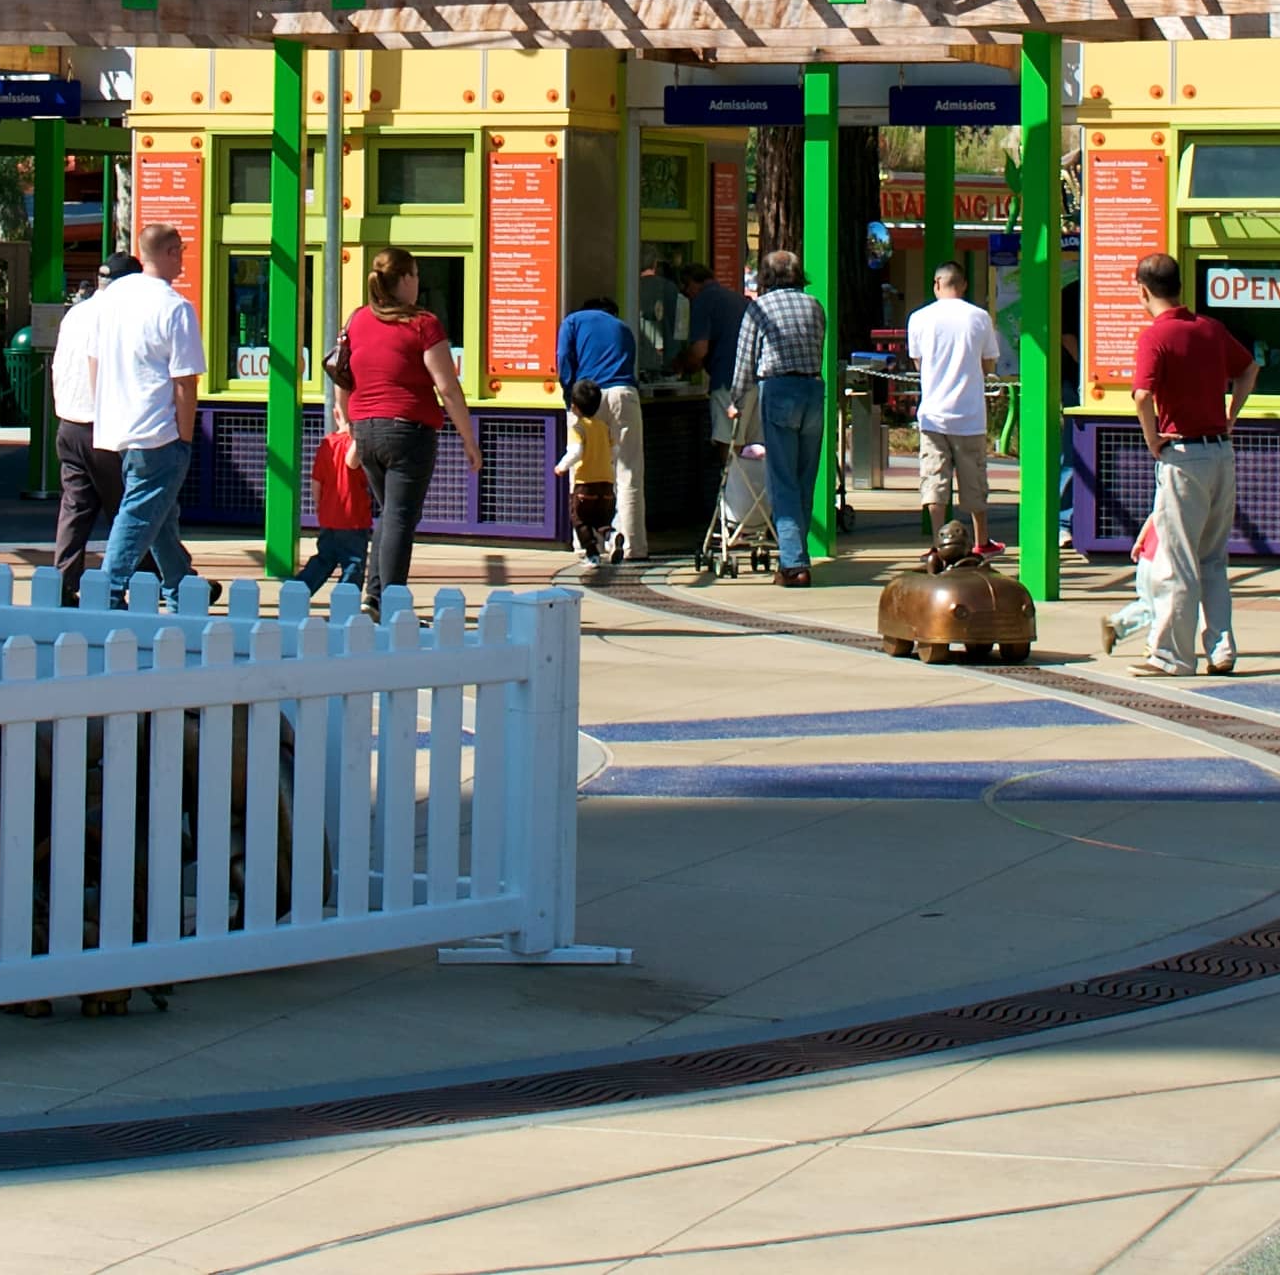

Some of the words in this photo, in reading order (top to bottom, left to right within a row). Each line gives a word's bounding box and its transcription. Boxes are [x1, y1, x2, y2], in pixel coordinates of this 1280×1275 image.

[709, 99, 768, 111] Admissions
[934, 99, 997, 111] Admissions
[881, 191, 988, 220] LEANG
